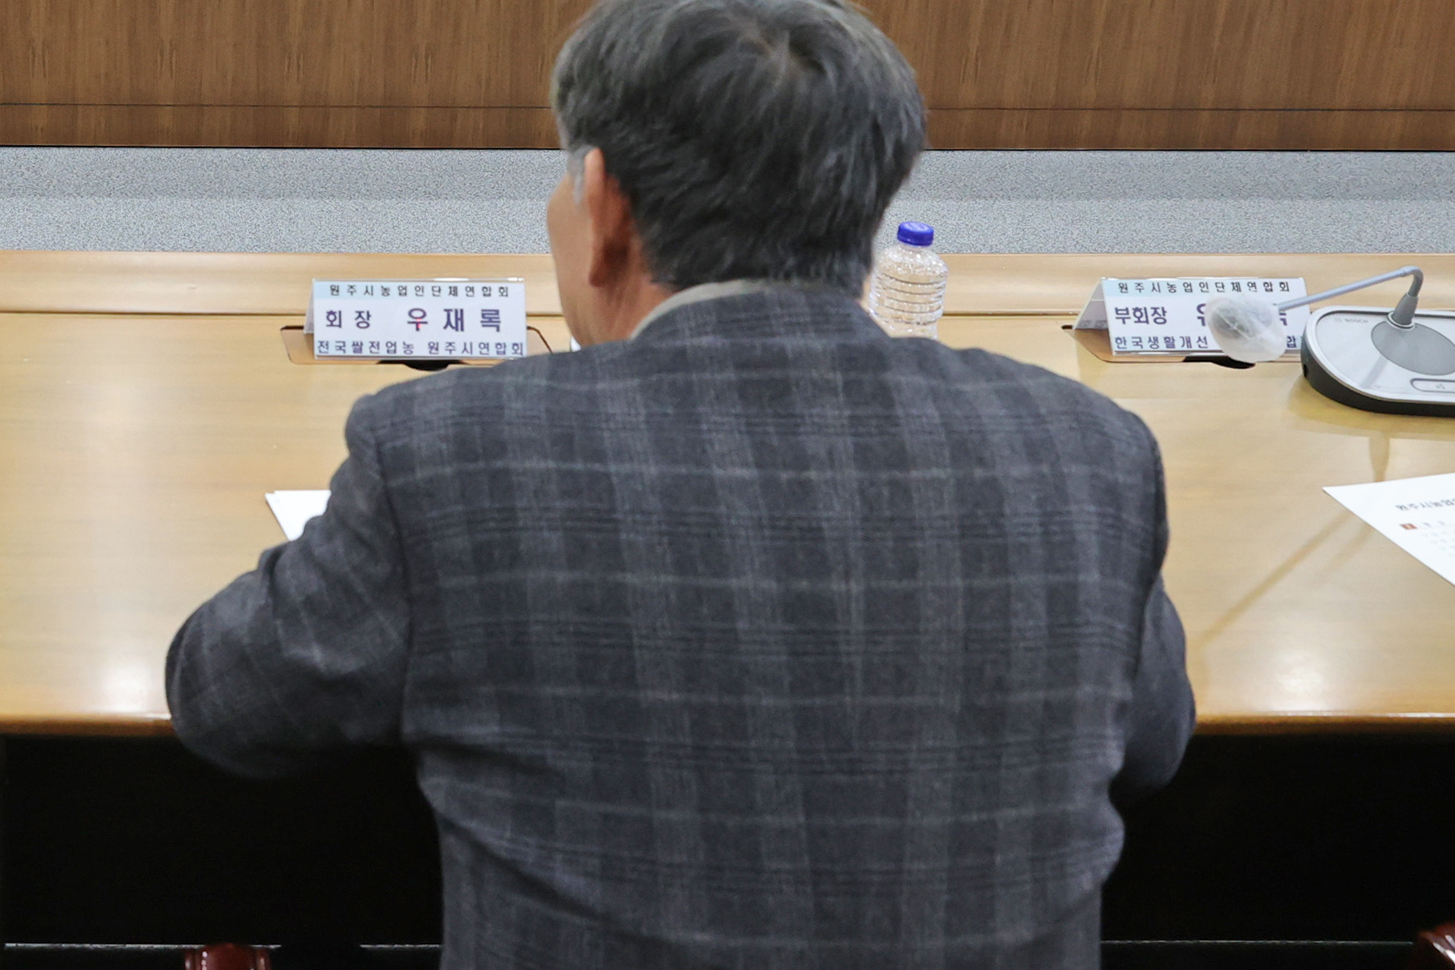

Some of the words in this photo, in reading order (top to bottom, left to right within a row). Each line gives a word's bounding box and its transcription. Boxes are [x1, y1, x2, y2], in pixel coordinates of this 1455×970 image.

[329, 285, 509, 298] 원주시농업인단체연합회
[1118, 281, 1290, 294] 원주시농업인단체연합회
[325, 310, 372, 329] 회장
[407, 308, 502, 332] 우재록
[1114, 306, 1167, 325] 부회장
[317, 340, 414, 355] 전국쌀전업농
[427, 341, 524, 356] 원주시연합회
